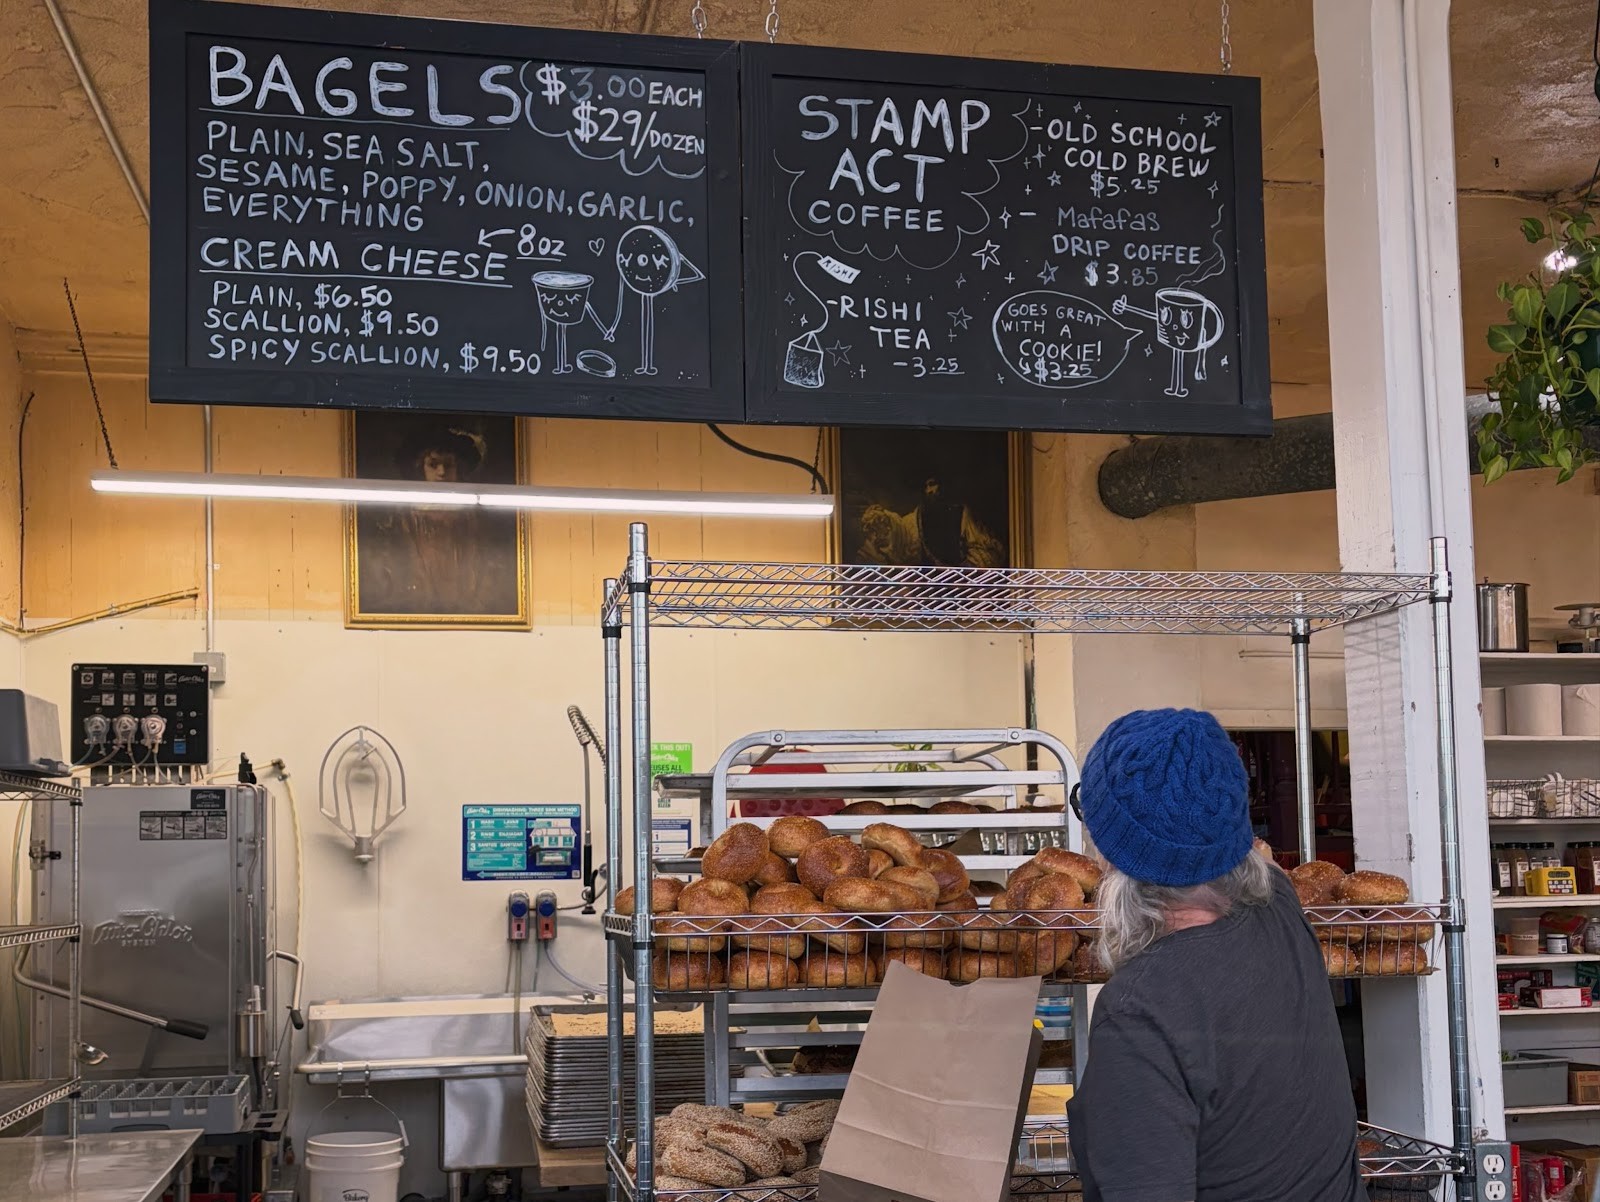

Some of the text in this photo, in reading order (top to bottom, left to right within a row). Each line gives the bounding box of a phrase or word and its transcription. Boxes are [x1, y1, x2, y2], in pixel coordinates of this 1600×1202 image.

[210, 45, 521, 126] BAGELS
[536, 63, 703, 108] $3.00 EACH
[799, 95, 990, 154] STAMP
[1111, 122, 1216, 154] SCHOOL
[207, 120, 489, 172] PLAIN, SEA SALT,
[829, 148, 945, 202] ACT
[1064, 147, 1210, 178] COLD BREW
[196, 153, 694, 227] SESAME, POPPY, ONION, GARLIC,
[1090, 170, 1160, 198] $5.25
[203, 186, 424, 232] EVERYTHING
[808, 200, 944, 232] COFFEE
[1058, 206, 1160, 231] Mafafas
[201, 237, 508, 281] CREAM CHEESE
[1052, 234, 1201, 265] DRIP COFFEE
[213, 280, 392, 310] PLAIN, $6.50
[204, 308, 439, 337] SCALLION, $9.50
[1001, 320, 1071, 339] WITH A
[1008, 303, 1106, 327] GOES GREAT
[869, 326, 931, 350] TEA
[1019, 339, 1102, 362] COOKIE!
[208, 334, 541, 374] SPICY SCALLION, $9.50
[1034, 356, 1093, 383] $3.25
[470, 831, 476, 840] 2
[470, 842, 476, 852] 3
